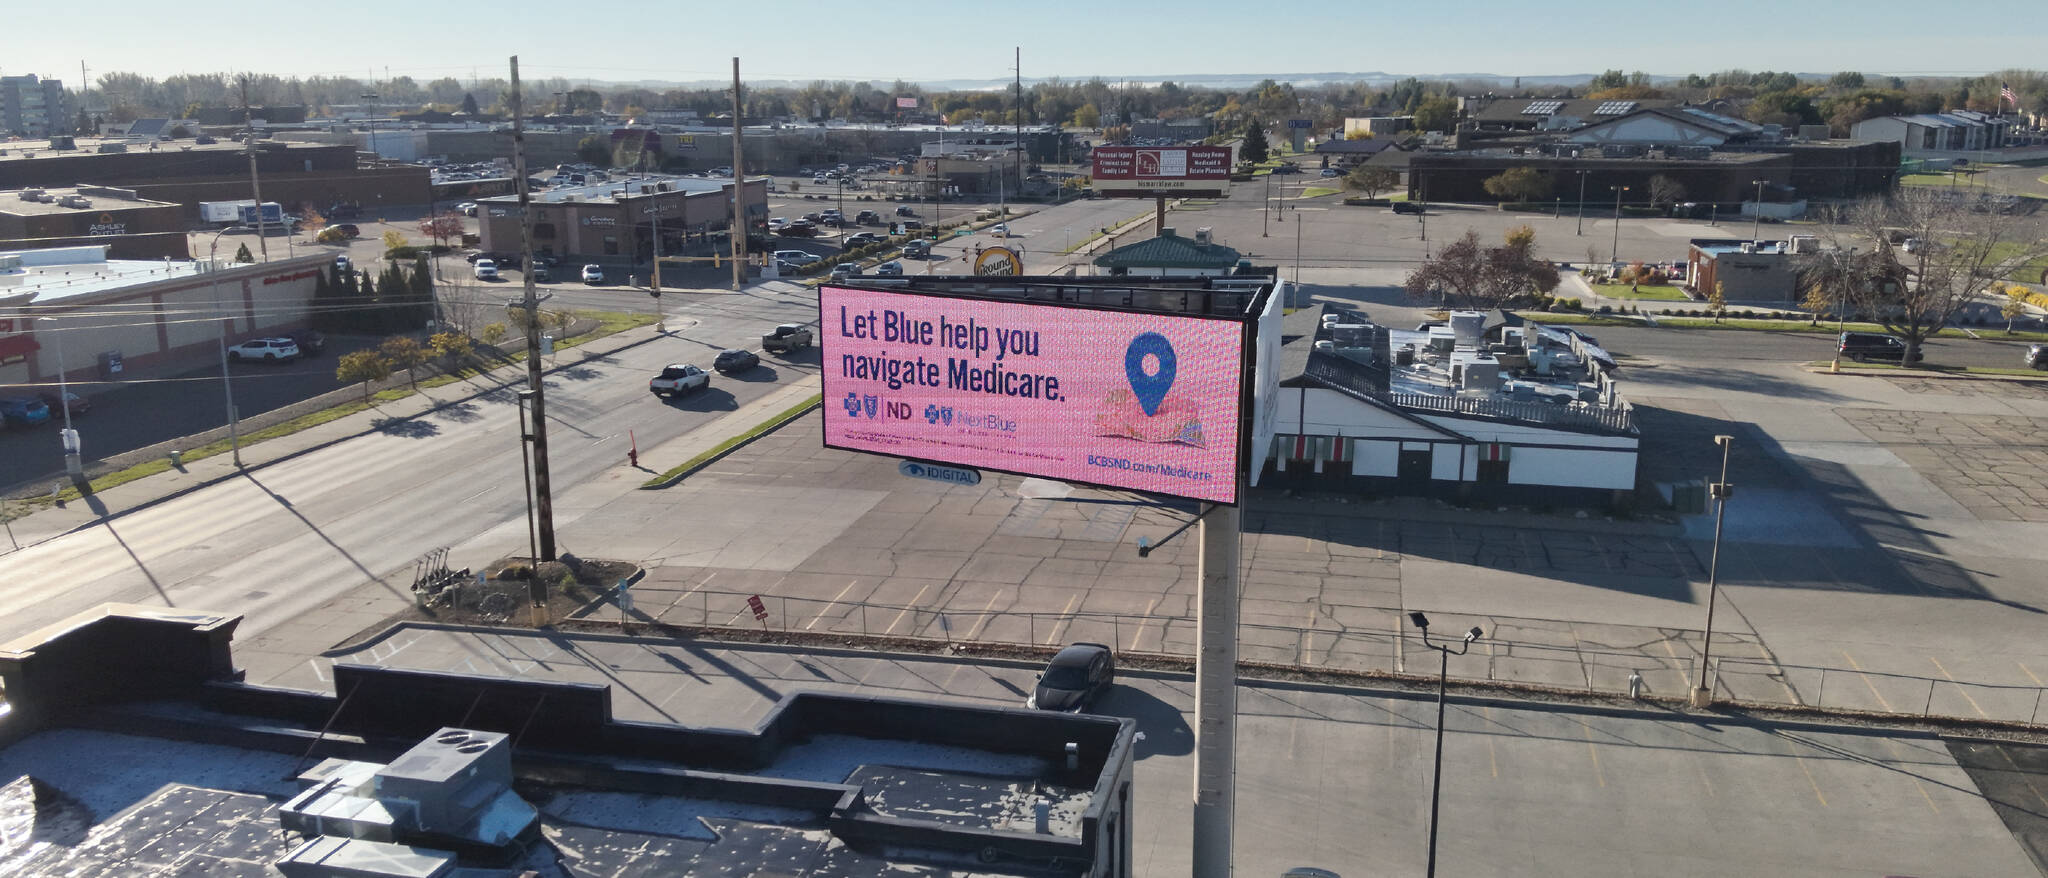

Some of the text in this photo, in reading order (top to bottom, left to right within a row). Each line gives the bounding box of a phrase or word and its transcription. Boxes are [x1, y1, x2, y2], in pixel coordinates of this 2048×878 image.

[841, 305, 1039, 361] Let Blue help you
[842, 350, 1065, 402] navigate Medicare.
[887, 401, 912, 420] ND
[927, 466, 975, 483] iDIGITAL
